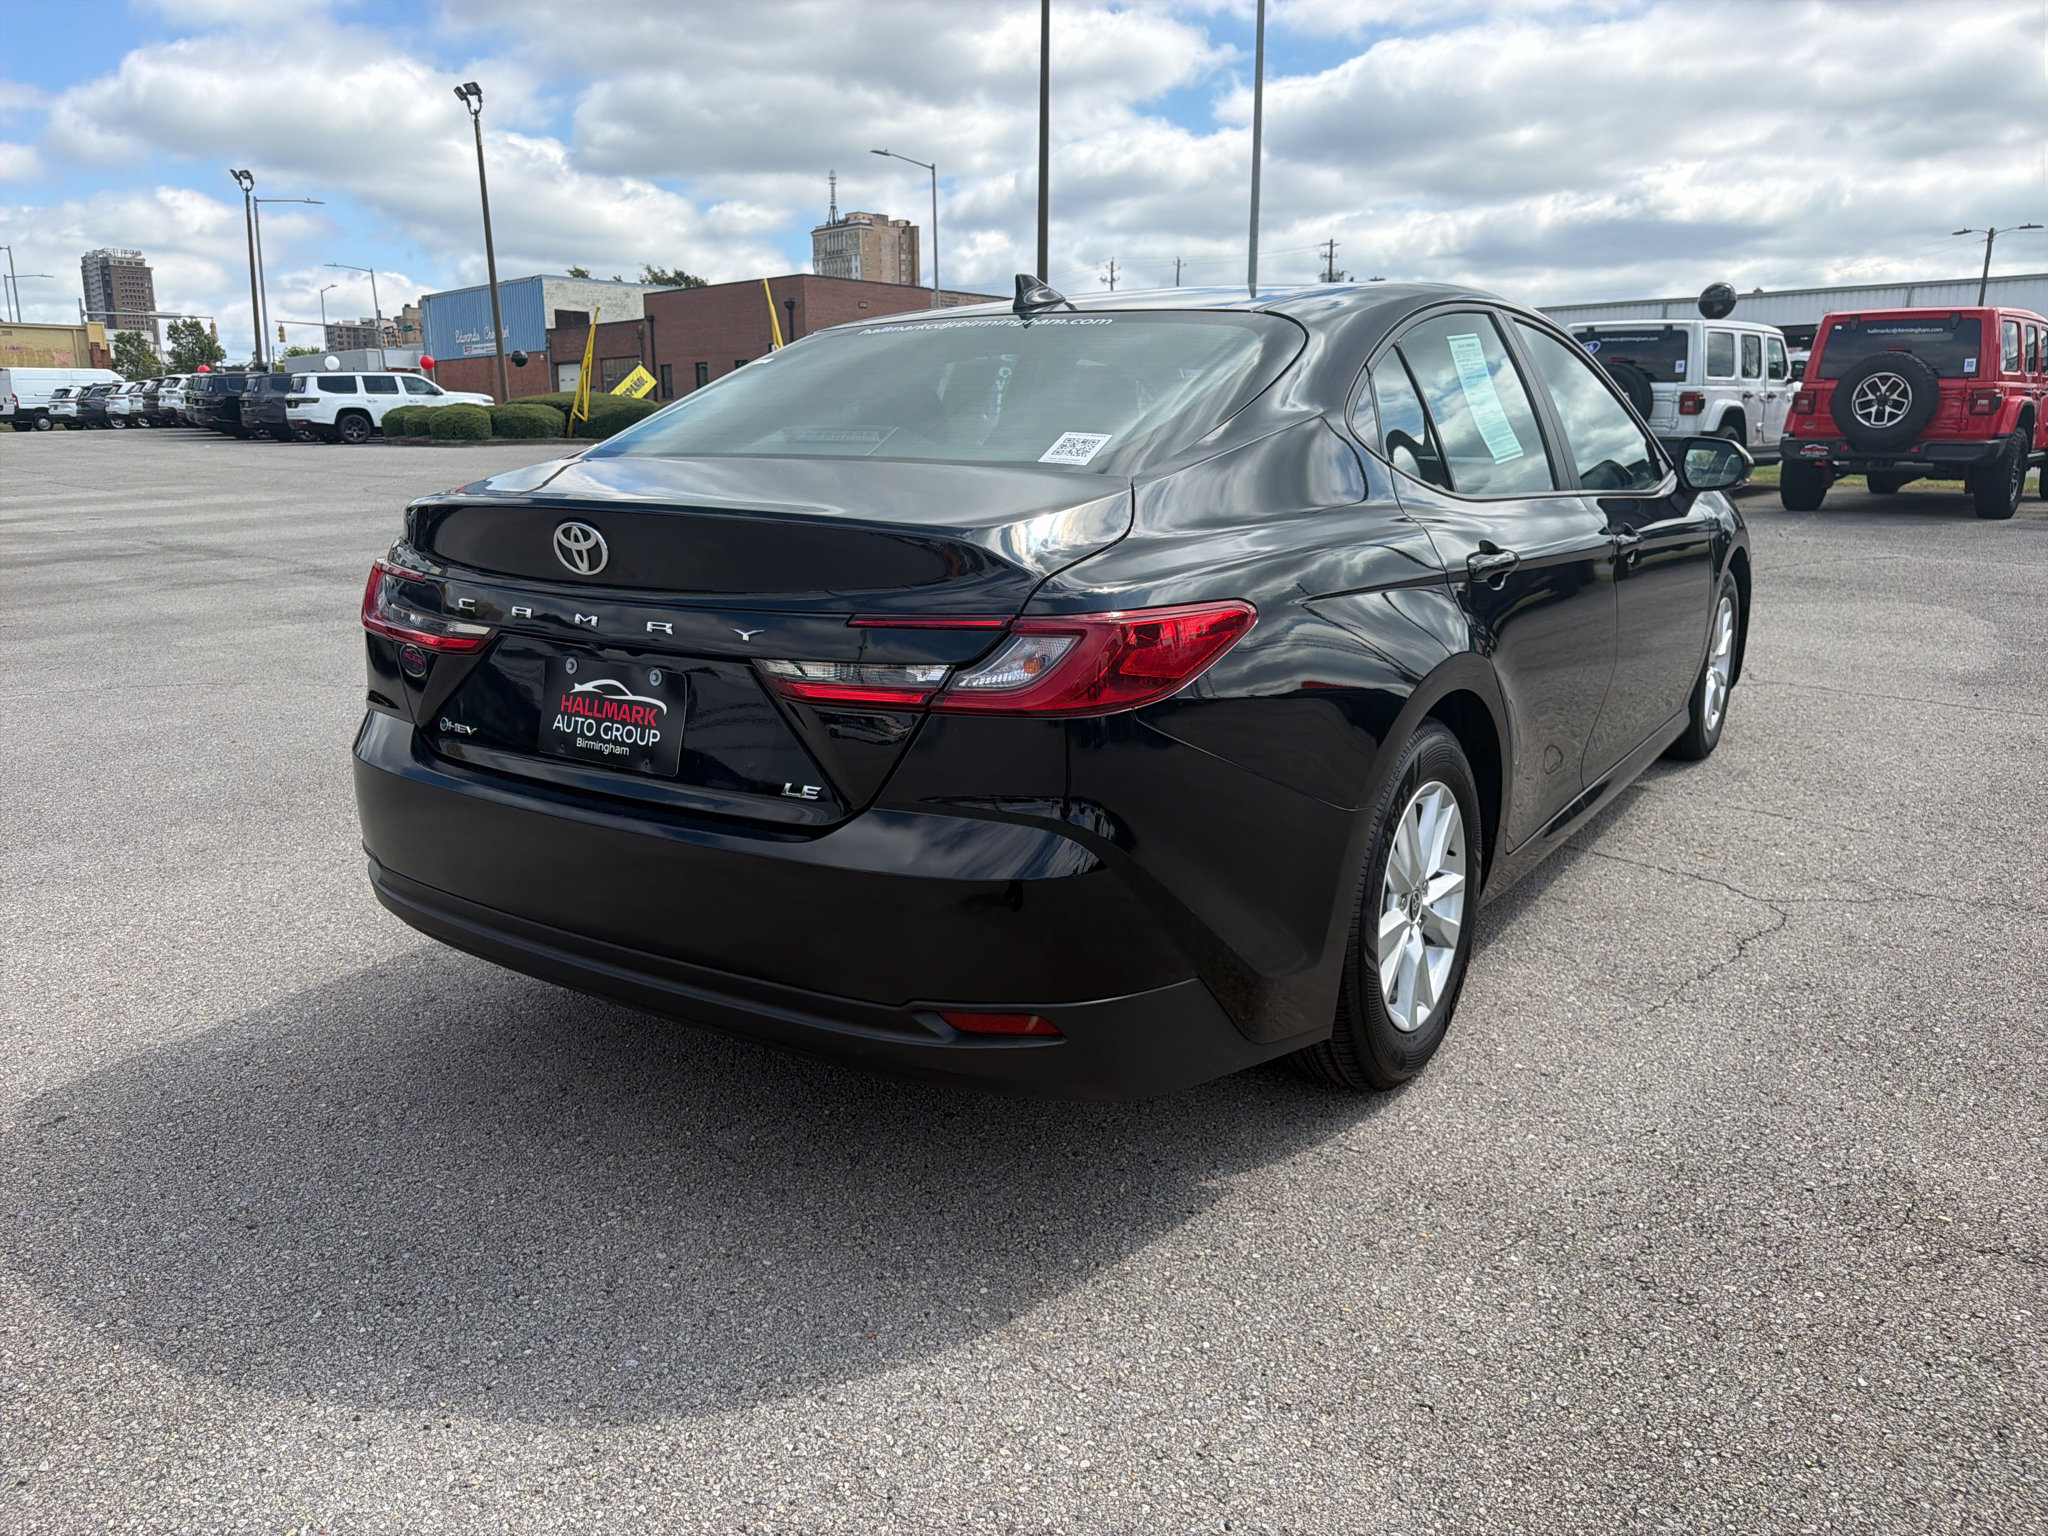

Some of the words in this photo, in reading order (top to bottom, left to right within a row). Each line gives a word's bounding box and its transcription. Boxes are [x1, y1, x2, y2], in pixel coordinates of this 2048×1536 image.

[458, 597, 765, 642] CAMRY
[560, 694, 659, 727] HALLMARK
[552, 714, 597, 737] AUTO
[600, 721, 661, 747] GROUP
[576, 737, 630, 756] Birmingham
[781, 782, 822, 800] LE
